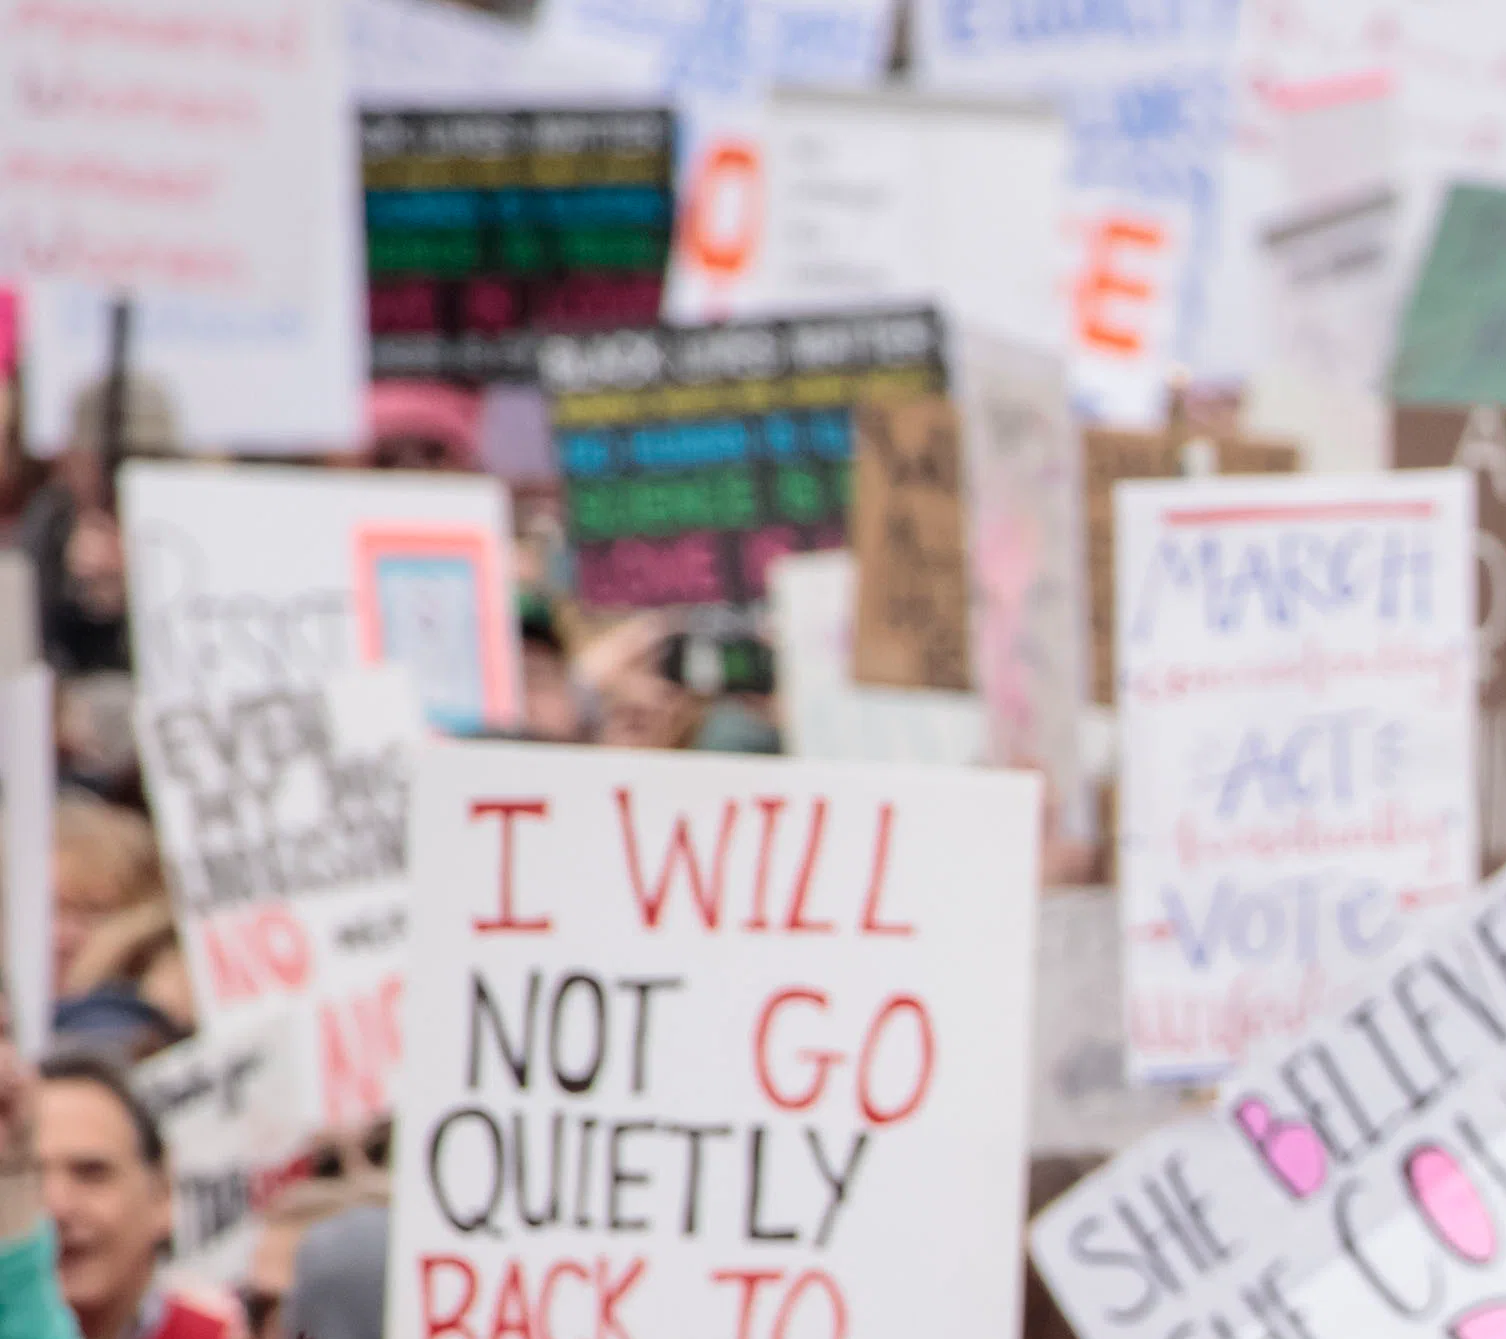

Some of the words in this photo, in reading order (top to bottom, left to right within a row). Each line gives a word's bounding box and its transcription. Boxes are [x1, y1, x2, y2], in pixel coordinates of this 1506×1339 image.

[1131, 526, 1434, 646] MARCH
[469, 800, 552, 933] I
[615, 786, 914, 936] WILL
[464, 965, 684, 1098] NOT
[753, 985, 936, 1125] GO
[427, 1108, 870, 1248] QUIETLY
[1067, 1148, 1232, 1328] SHE
